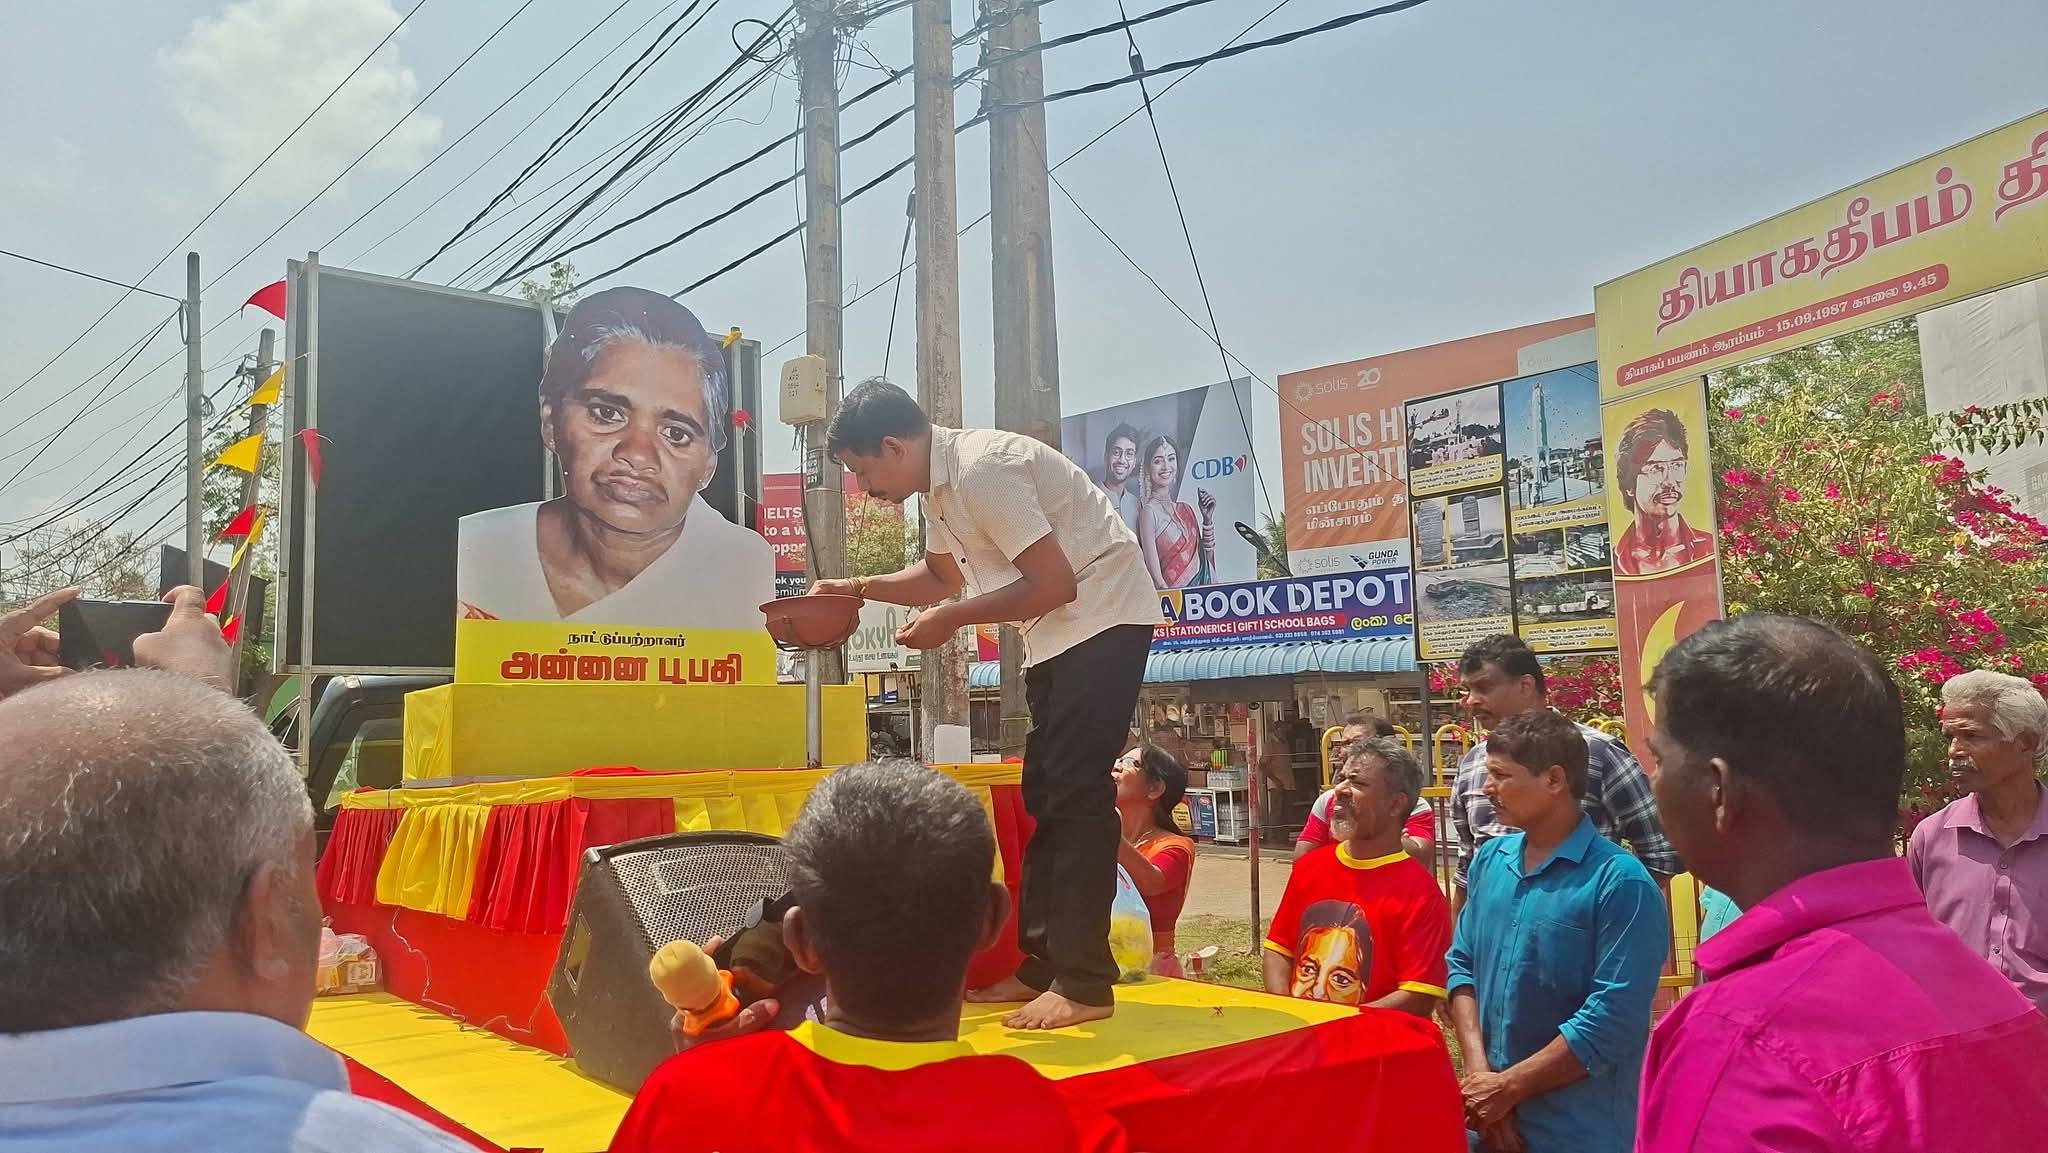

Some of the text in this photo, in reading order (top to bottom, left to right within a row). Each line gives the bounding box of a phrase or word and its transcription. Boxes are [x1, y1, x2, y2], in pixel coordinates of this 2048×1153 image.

[1657, 167, 1972, 334] தியாகதீபம்
[1624, 357, 1665, 383] தியாகப்
[1667, 342, 1710, 369] பயணம்
[1712, 326, 1765, 353] ஆரம்பம்
[1776, 301, 1848, 333] 15.09.1987
[1852, 286, 1899, 310] காலை
[1902, 273, 1937, 293] 9.45
[1302, 412, 1373, 455] SOLIS
[1191, 456, 1234, 480] CDB
[764, 507, 802, 519] IELTS
[1305, 494, 1384, 516] எப்போதும்
[1306, 511, 1372, 530] மின்சாரம்
[782, 527, 790, 536] a
[1314, 555, 1341, 569] solis
[1368, 549, 1399, 560] GUNDA
[1372, 558, 1397, 566] POWER
[775, 587, 807, 596] emium
[1185, 585, 1280, 621] BOOK
[1288, 573, 1408, 613] DEPOT
[849, 606, 897, 650] OKYA
[1170, 623, 1233, 637] STATIONERICE
[1238, 620, 1258, 633] GIFT
[1265, 617, 1306, 630] SCHOOL
[1307, 615, 1336, 628] BAGS
[1351, 615, 1388, 631] ලංකා
[568, 630, 686, 648] நாட்டுப்பற்றாளர்
[500, 648, 743, 684] அன்னை பூபதி
